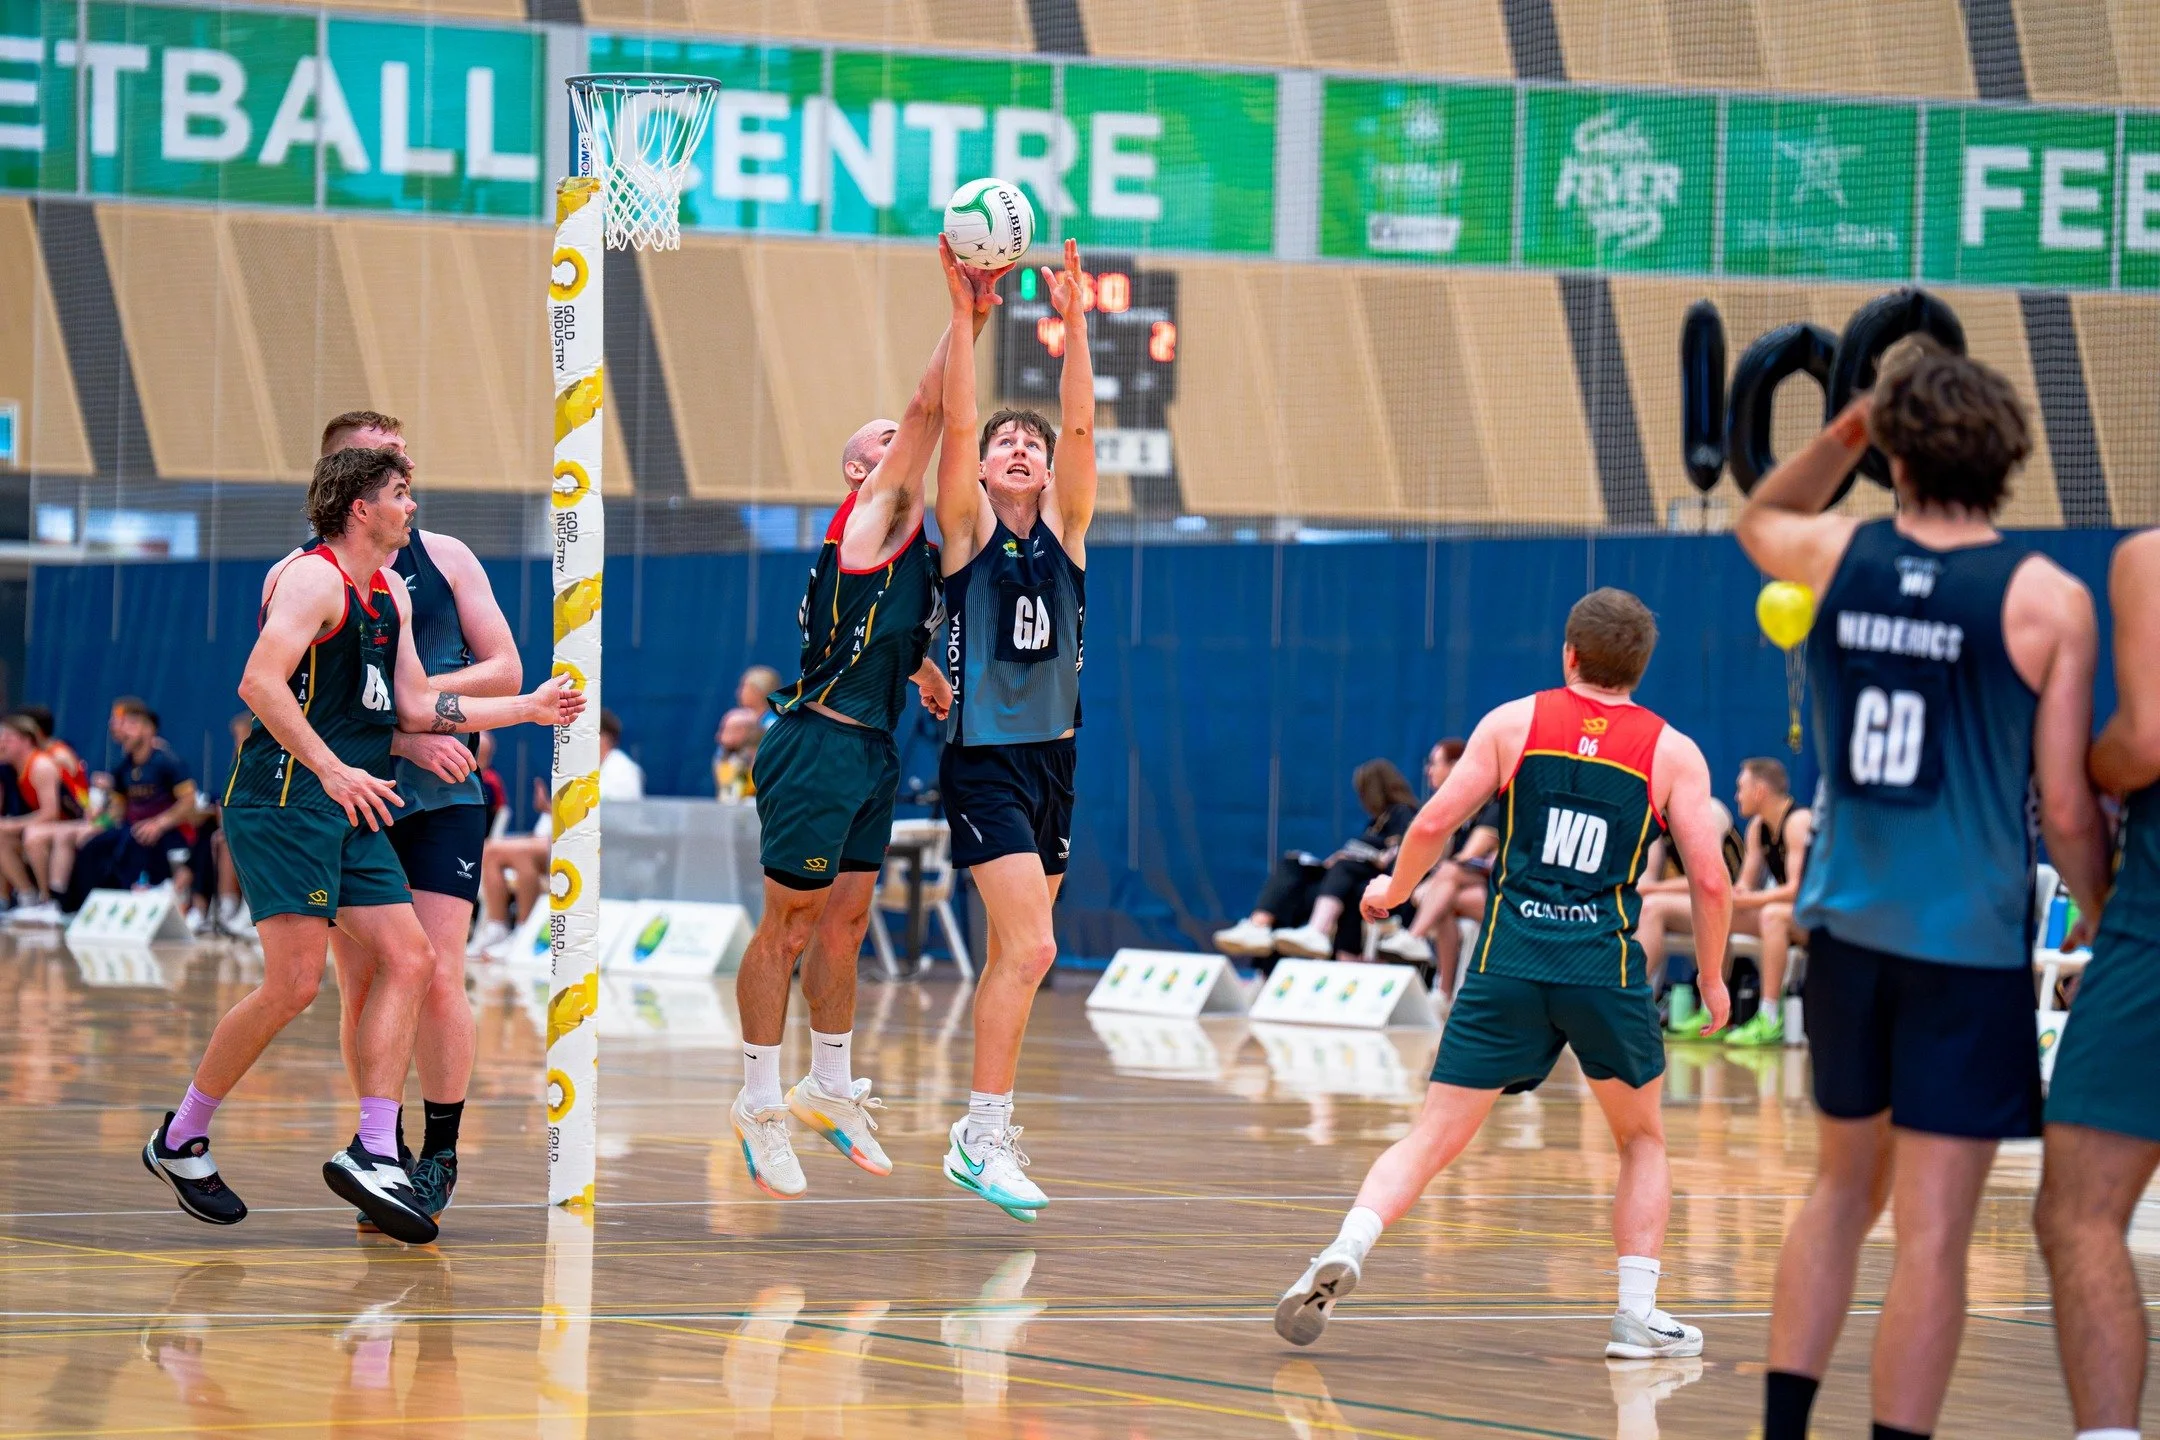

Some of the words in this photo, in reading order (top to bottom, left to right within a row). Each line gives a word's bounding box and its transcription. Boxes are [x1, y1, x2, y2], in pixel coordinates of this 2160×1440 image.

[612, 84, 1165, 222] CENTRE
[998, 190, 1022, 255] GILBERT
[553, 305, 565, 372] INDUSTRY
[563, 305, 576, 341] GOLD
[565, 511, 579, 543] GOLD
[1013, 595, 1051, 650] GA
[1850, 685, 1927, 787] GD
[1541, 806, 1608, 875] WD
[556, 914, 567, 950] GOLD
[1519, 899, 1599, 924] GUNTON
[551, 1126, 560, 1163] GOLD
